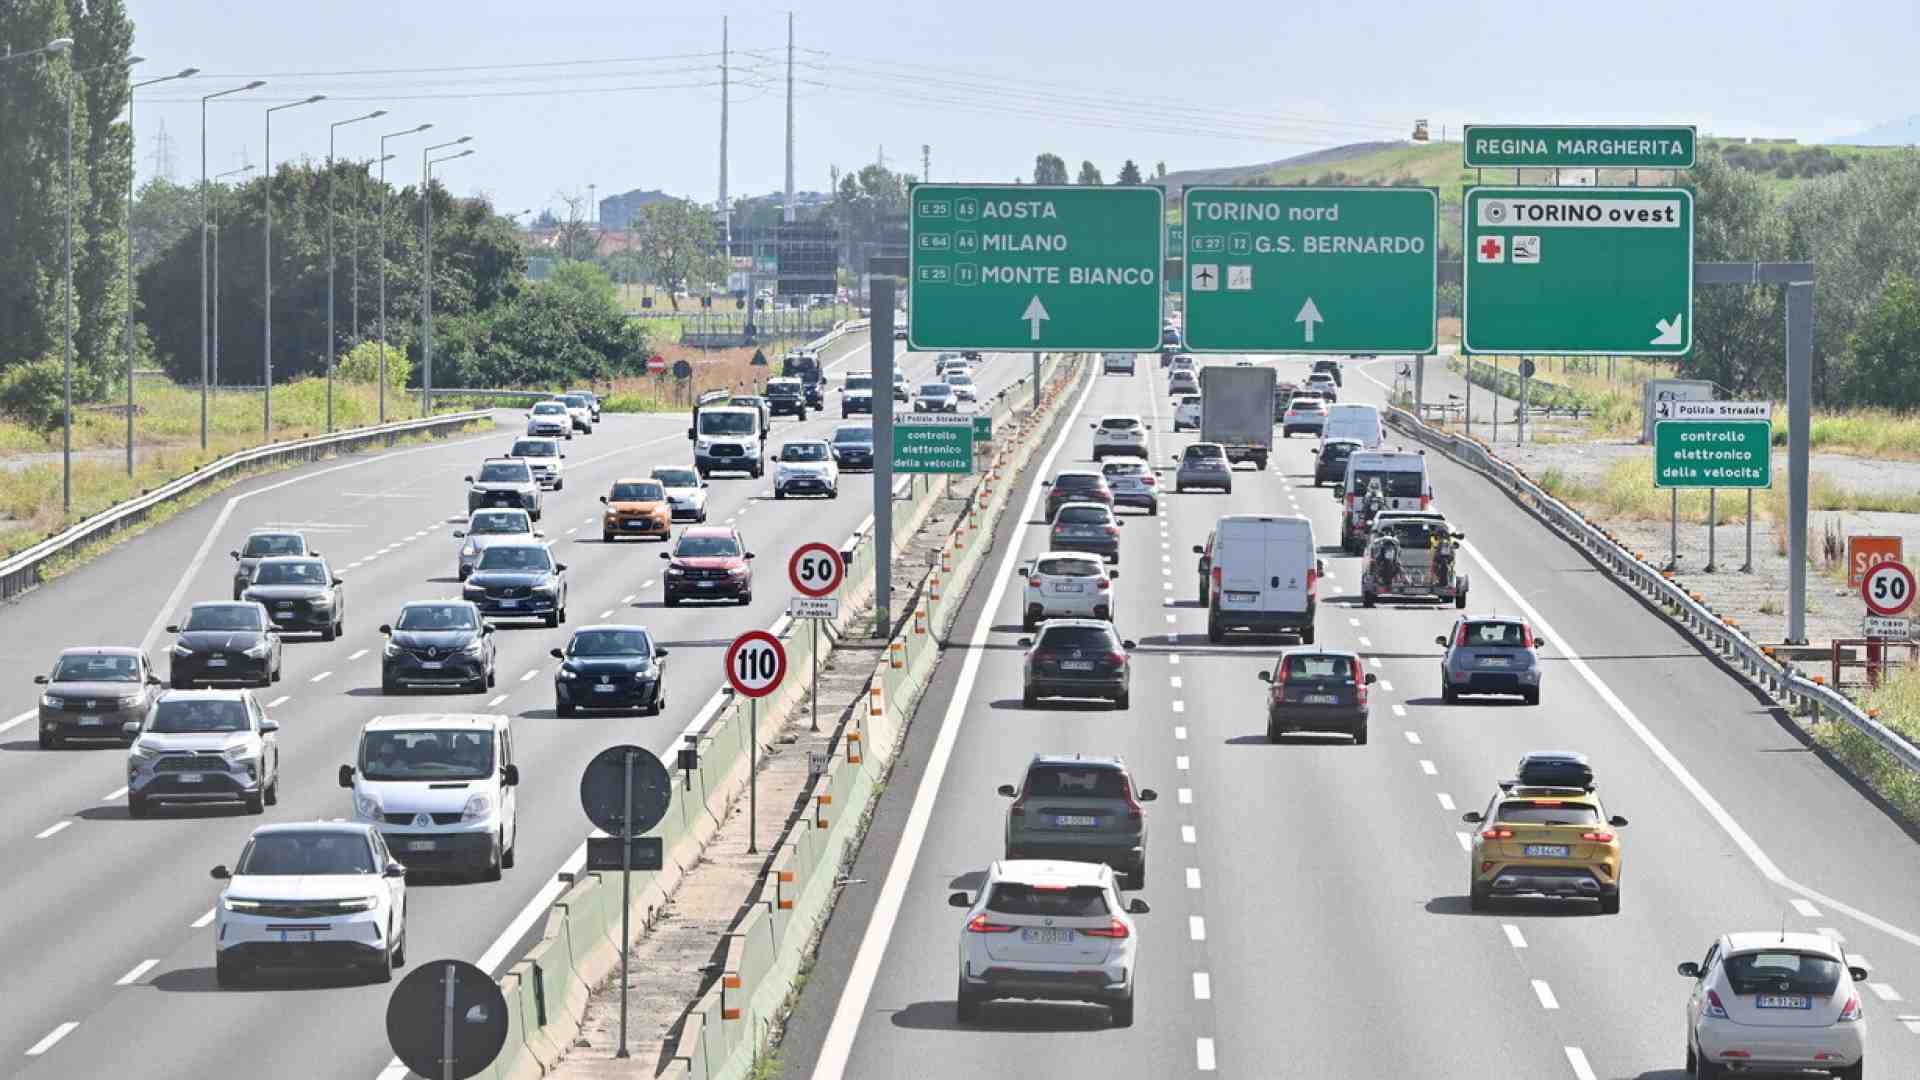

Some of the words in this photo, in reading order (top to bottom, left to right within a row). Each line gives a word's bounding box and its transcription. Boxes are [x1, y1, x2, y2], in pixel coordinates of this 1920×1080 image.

[1475, 138, 1548, 155] REGINA
[1557, 138, 1684, 155] MARGHERITA
[933, 204, 947, 214] 25
[959, 203, 975, 215] A5
[982, 201, 1057, 218] AOSTA
[1191, 202, 1280, 221] TORINO
[1289, 203, 1339, 221] nord
[1513, 204, 1602, 222] TORINO
[1608, 207, 1675, 223] ovest
[983, 234, 1067, 252] MILANO
[1255, 236, 1296, 253] G.S.
[1303, 235, 1425, 254] BERNARDO
[932, 269, 947, 279] 25
[982, 267, 1061, 284] MONTE
[1069, 267, 1154, 285] BIANCO
[1680, 405, 1715, 416] Polizia
[1720, 405, 1766, 416] Stradale
[907, 431, 957, 440] controllo
[1680, 431, 1745, 442] controllo
[902, 445, 962, 454] elettronico
[1674, 449, 1752, 460] elettronico
[894, 458, 920, 468] della
[1663, 467, 1697, 478] della
[801, 558, 832, 581] 50
[1874, 576, 1905, 600] 50
[738, 649, 776, 680] 110
